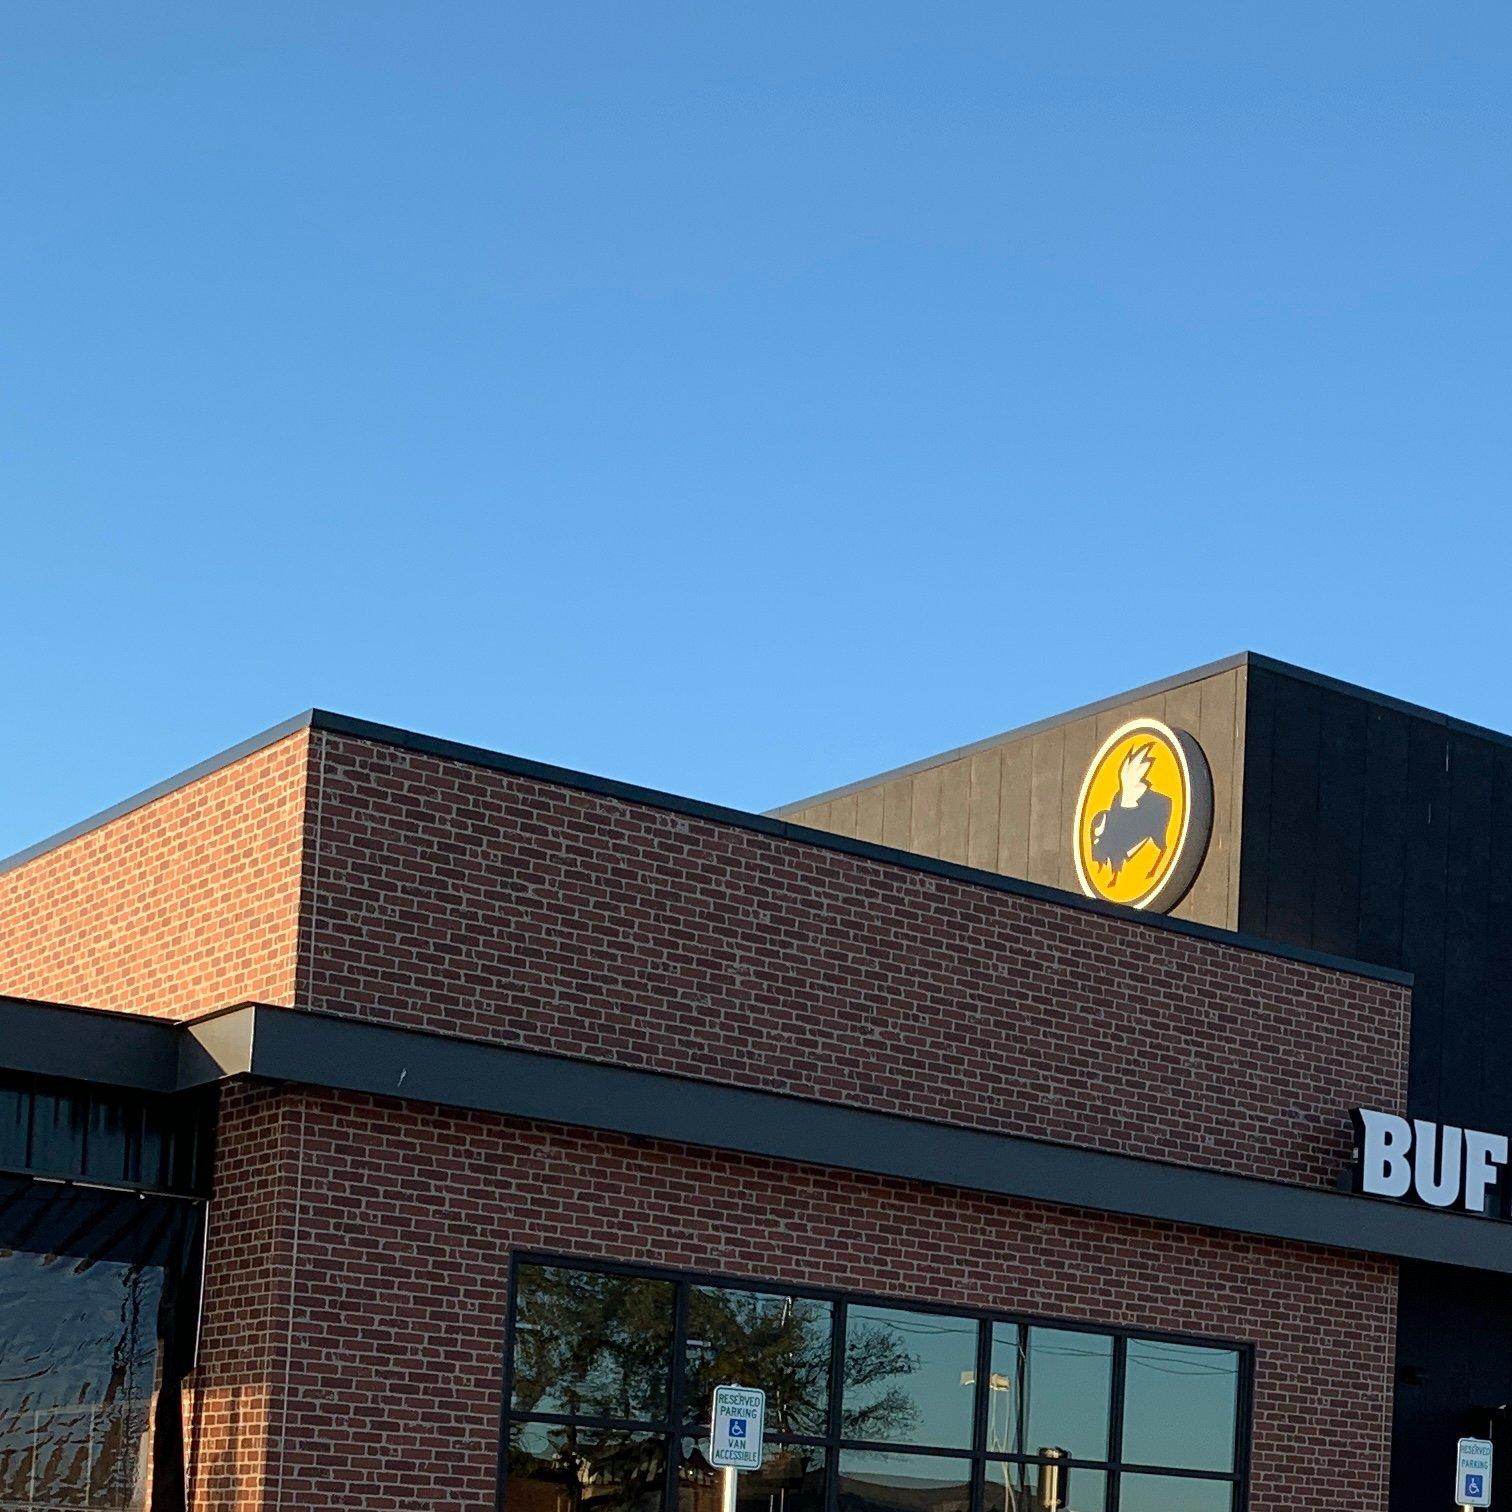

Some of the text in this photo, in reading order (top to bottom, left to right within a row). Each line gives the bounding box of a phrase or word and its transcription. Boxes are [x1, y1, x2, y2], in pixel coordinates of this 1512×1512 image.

[718, 1393, 760, 1407] RESERVED
[720, 1405, 757, 1419] PARKING
[728, 1438, 746, 1449] VAN
[715, 1449, 757, 1462] ACCESSIBLE
[1461, 1458, 1489, 1470] PARKING
